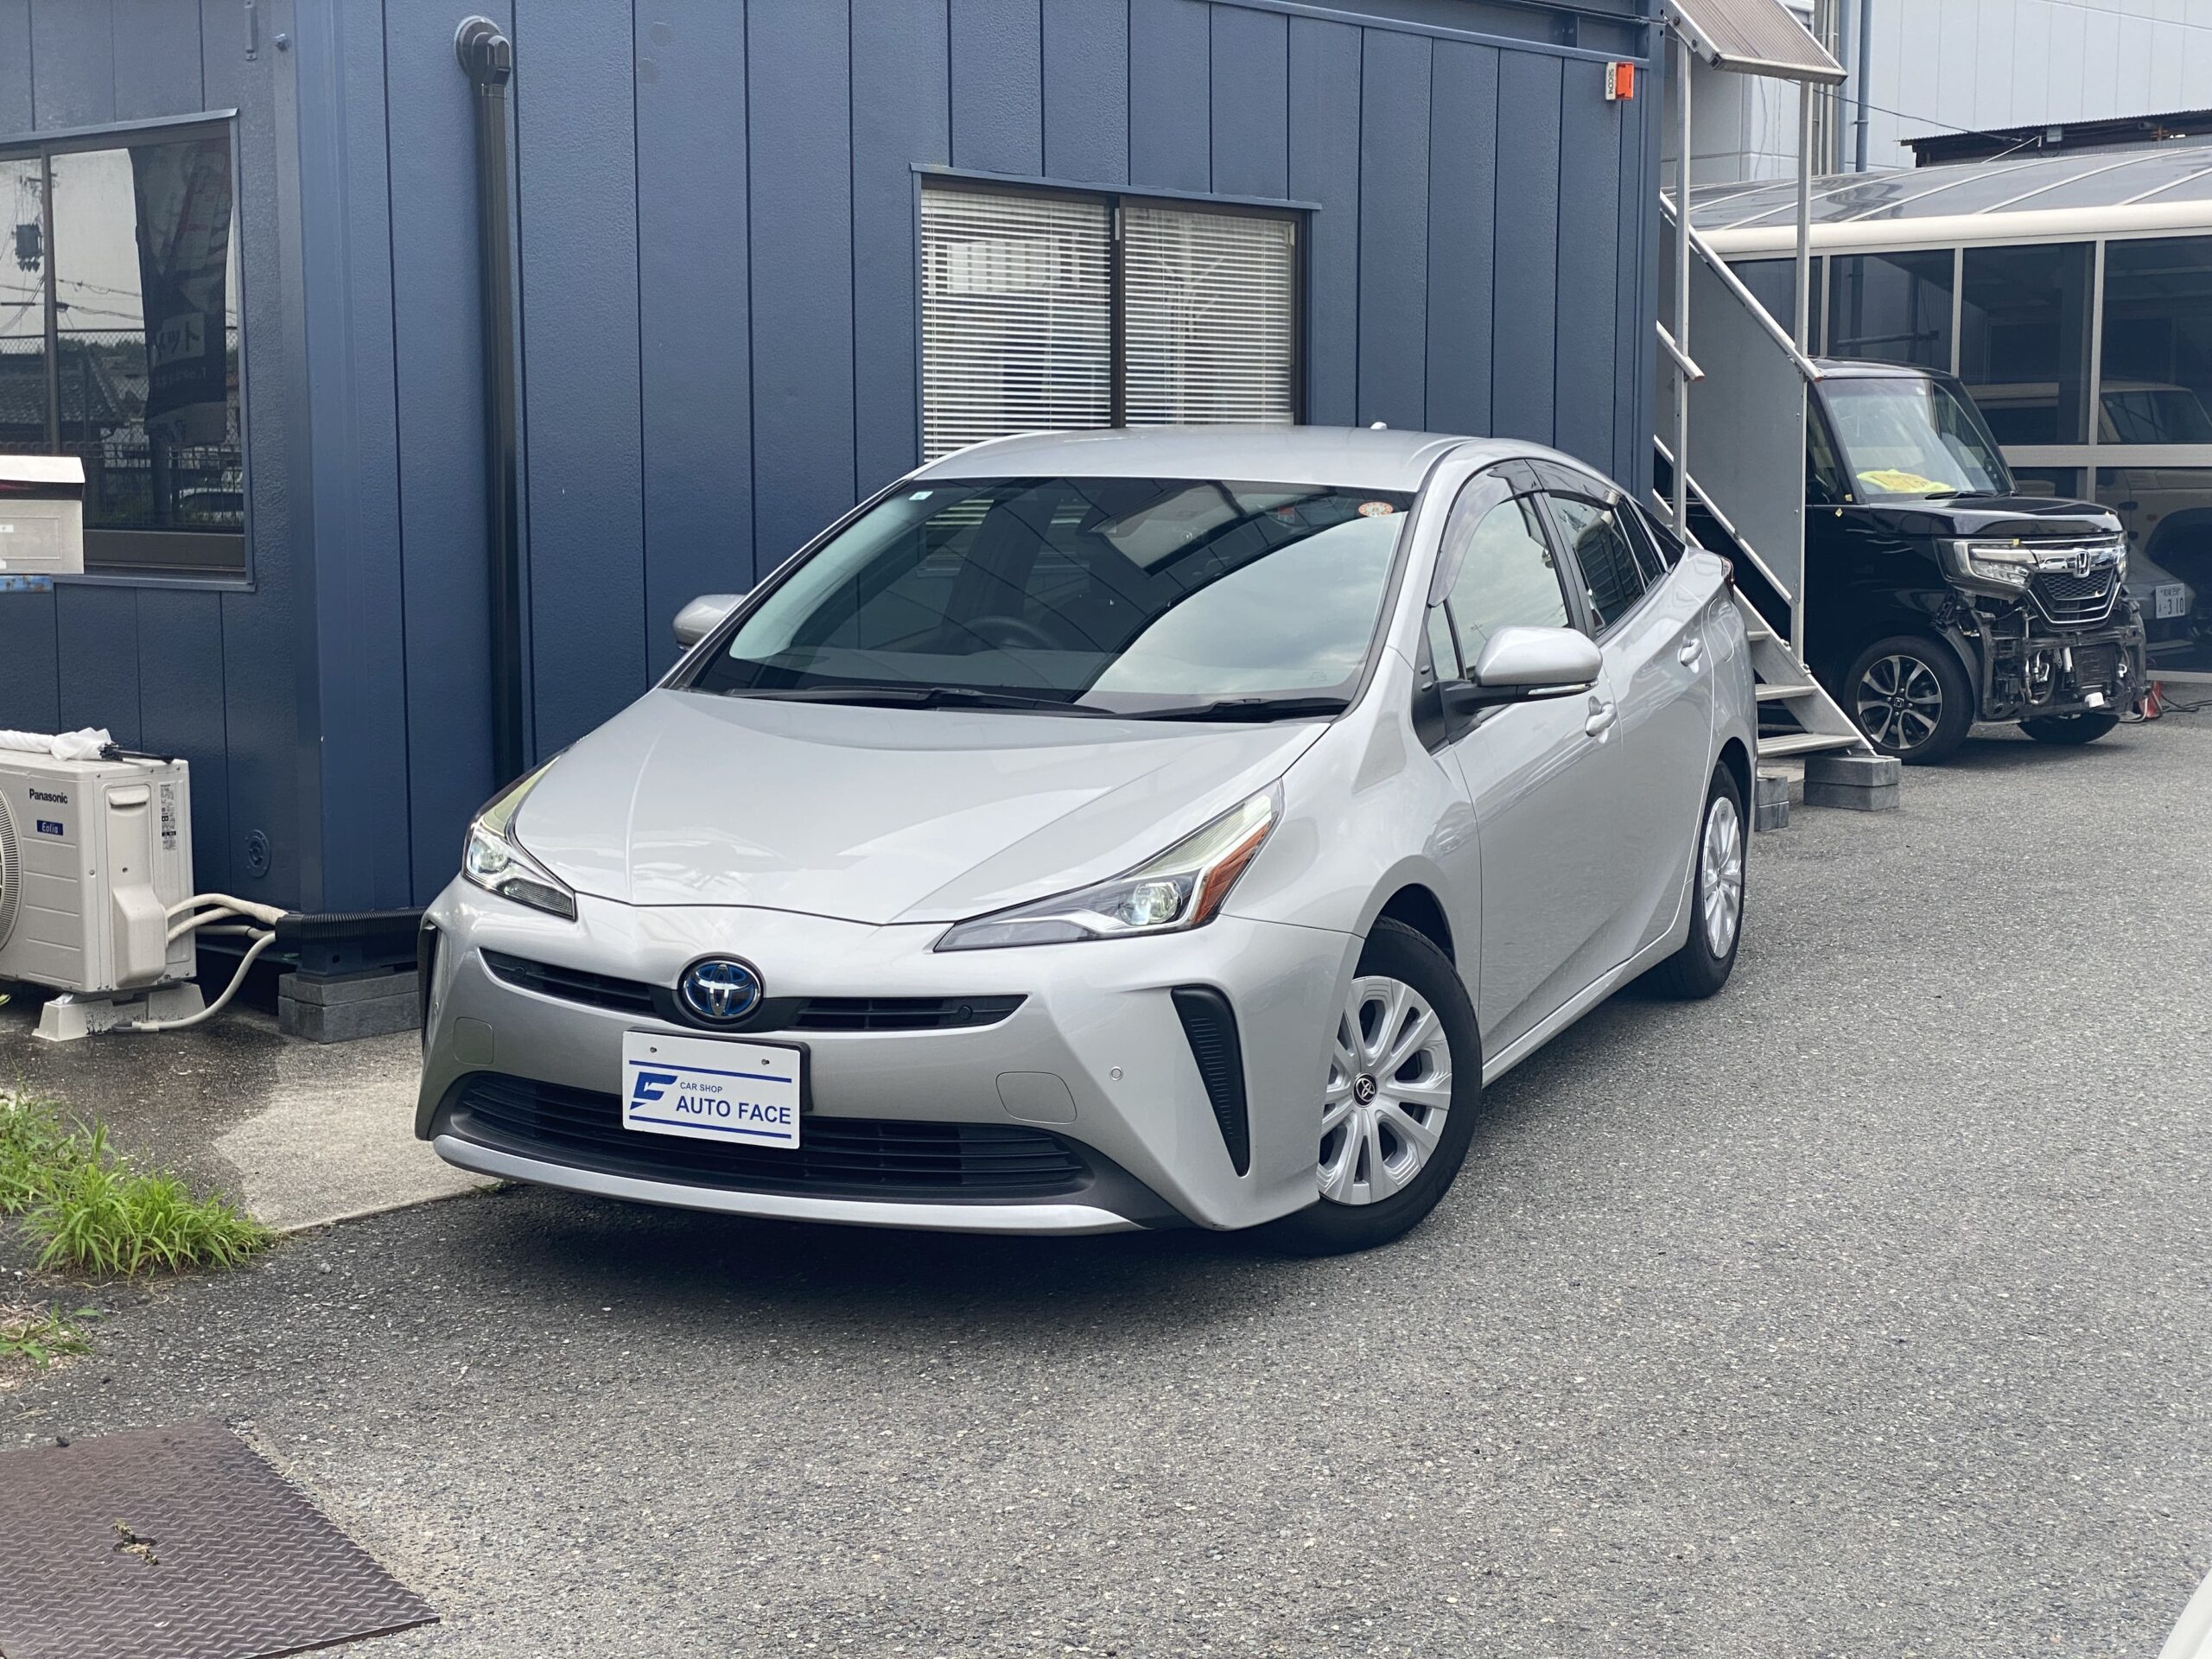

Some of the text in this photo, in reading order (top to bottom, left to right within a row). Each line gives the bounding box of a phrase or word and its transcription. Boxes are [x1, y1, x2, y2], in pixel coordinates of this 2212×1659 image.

[29, 787, 68, 804] Panasonic
[41, 822, 59, 834] Eolia
[680, 1082, 723, 1093] CAR SHOP
[676, 1096, 791, 1124] AUTO FACE
